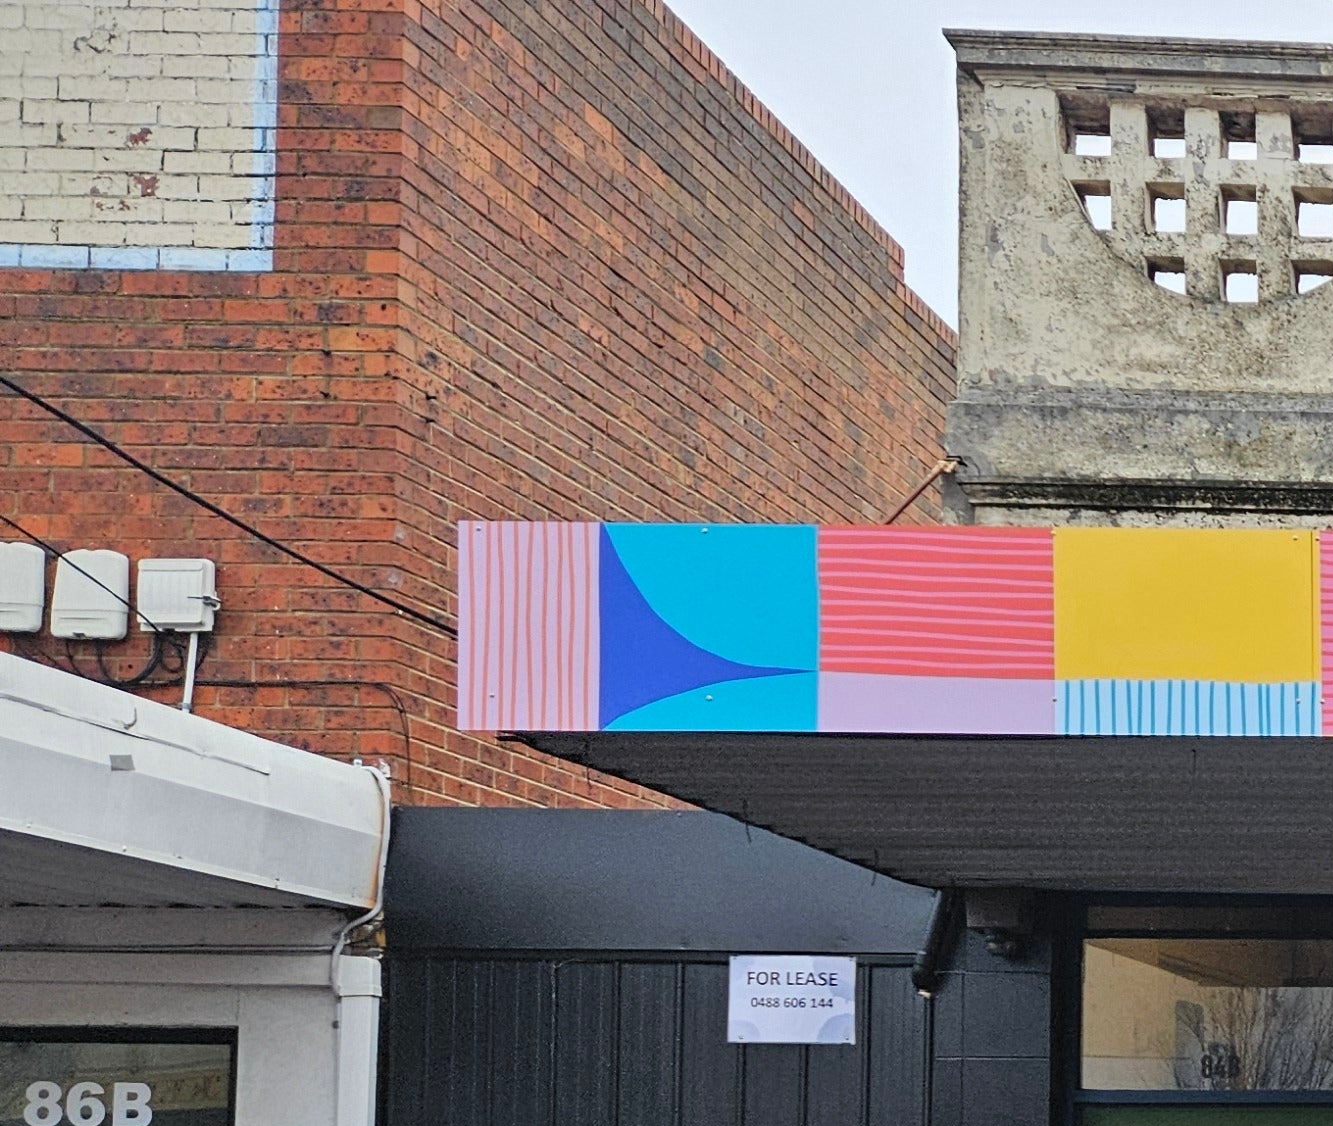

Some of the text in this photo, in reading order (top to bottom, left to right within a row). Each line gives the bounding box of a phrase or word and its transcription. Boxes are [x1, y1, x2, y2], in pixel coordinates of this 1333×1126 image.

[746, 971, 839, 986] FOR LEASE
[750, 997, 834, 1009] 0488 606 144
